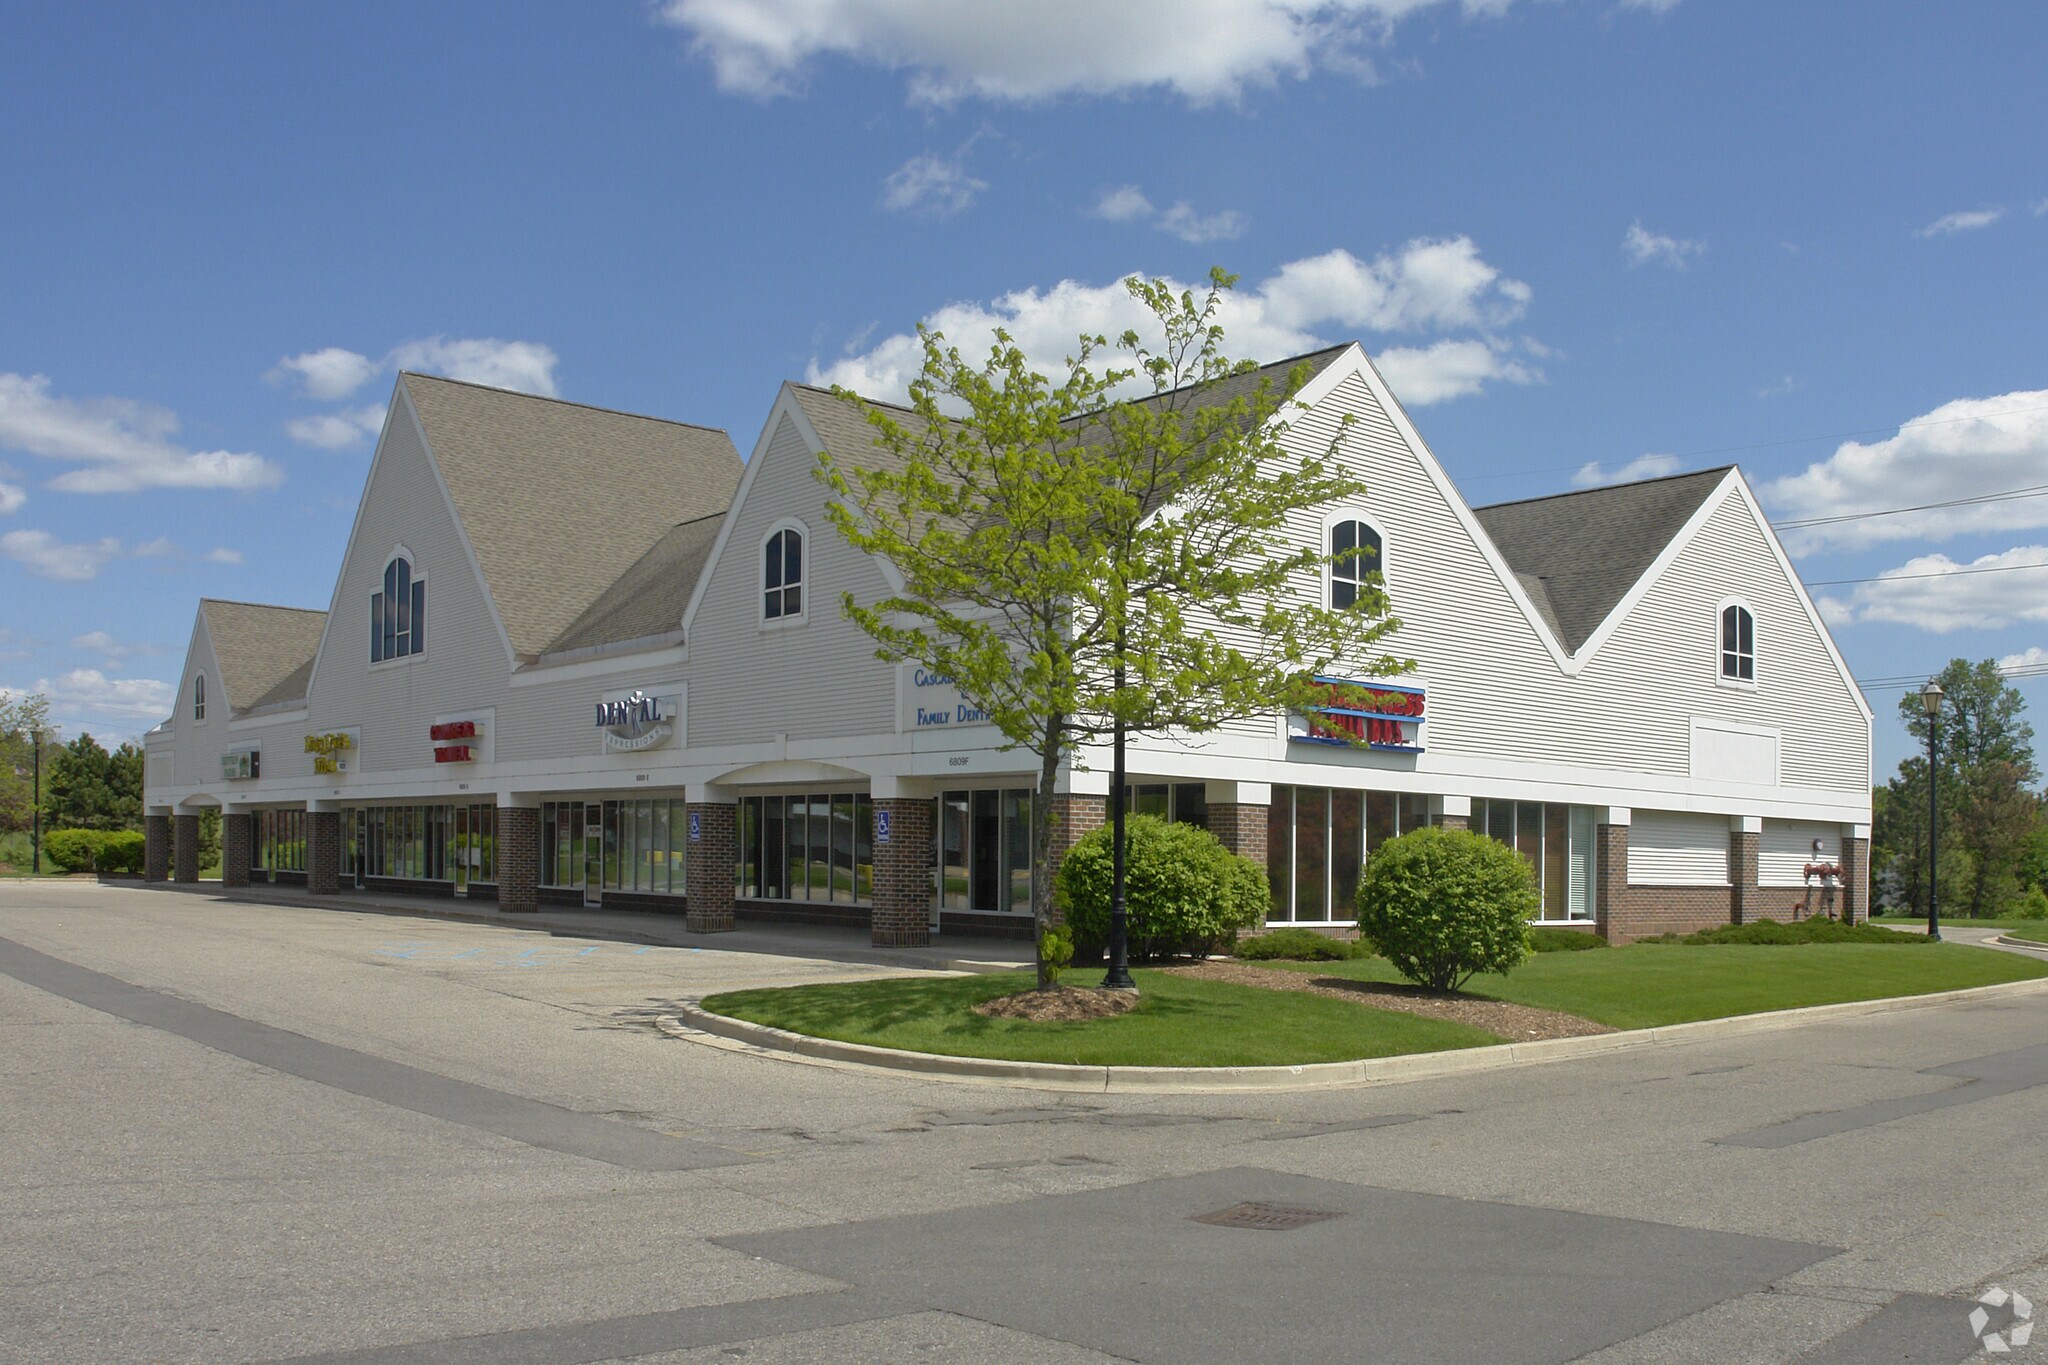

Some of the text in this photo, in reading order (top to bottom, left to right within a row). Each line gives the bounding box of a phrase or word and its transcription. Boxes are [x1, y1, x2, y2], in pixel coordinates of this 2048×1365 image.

[596, 691, 661, 734] DENTAL
[917, 708, 950, 726] FAMILY
[605, 730, 660, 748] EXPRESSIONS
[949, 757, 969, 766] 6809F
